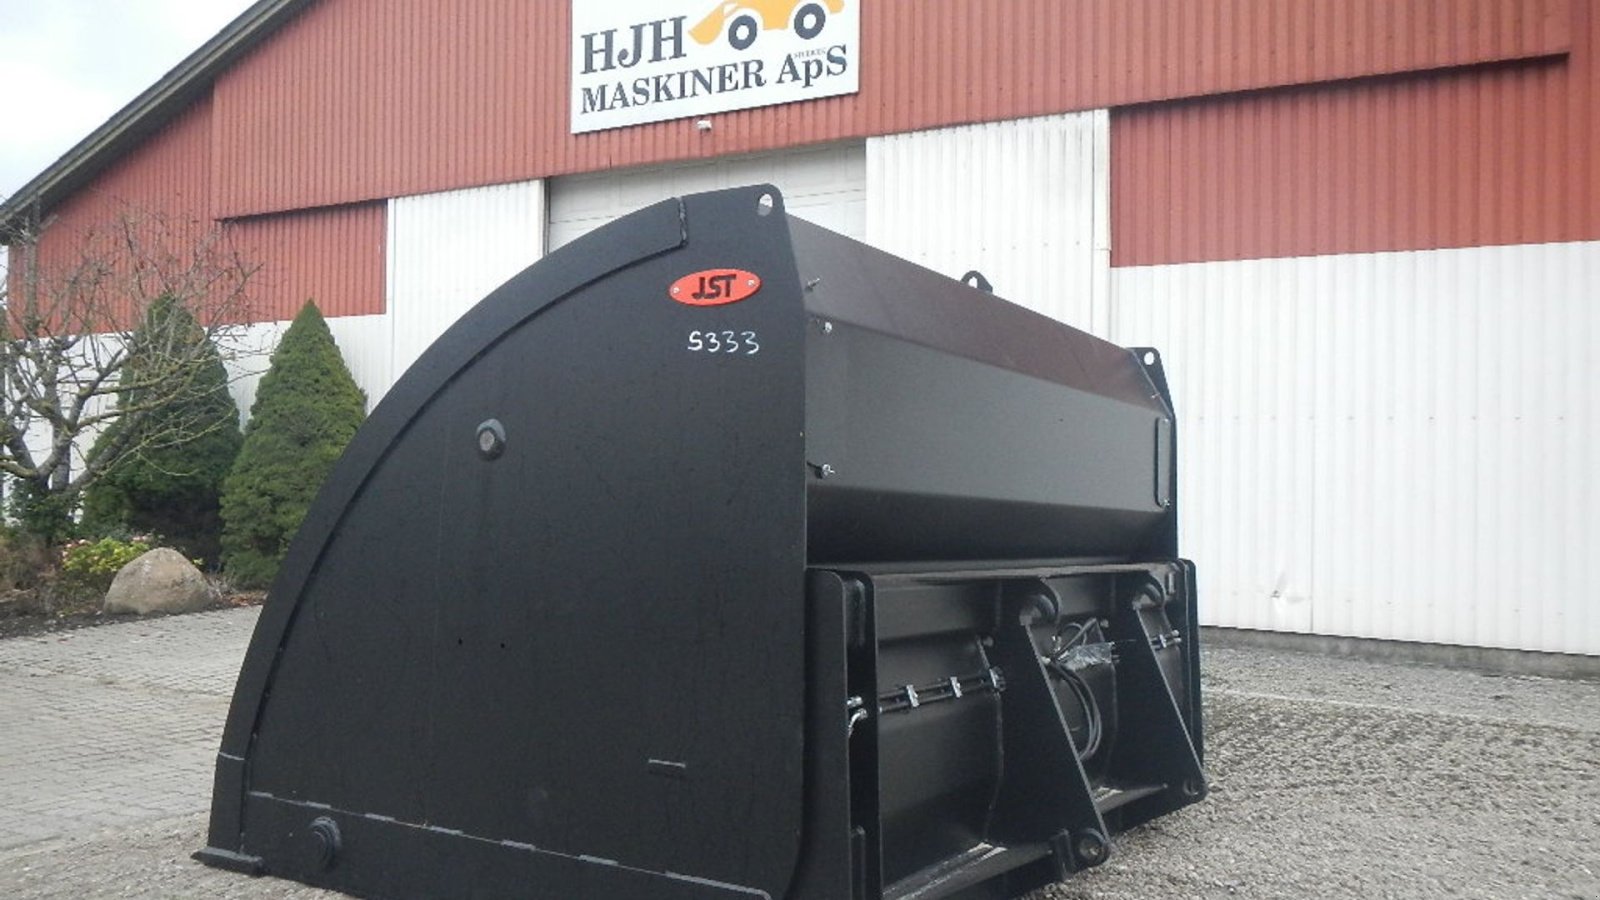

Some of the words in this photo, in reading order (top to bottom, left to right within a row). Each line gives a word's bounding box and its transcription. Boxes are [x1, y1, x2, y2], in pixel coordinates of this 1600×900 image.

[580, 16, 687, 74] HJH
[580, 59, 766, 114] MASKINER
[776, 45, 847, 88] ApS
[691, 273, 737, 300] JST
